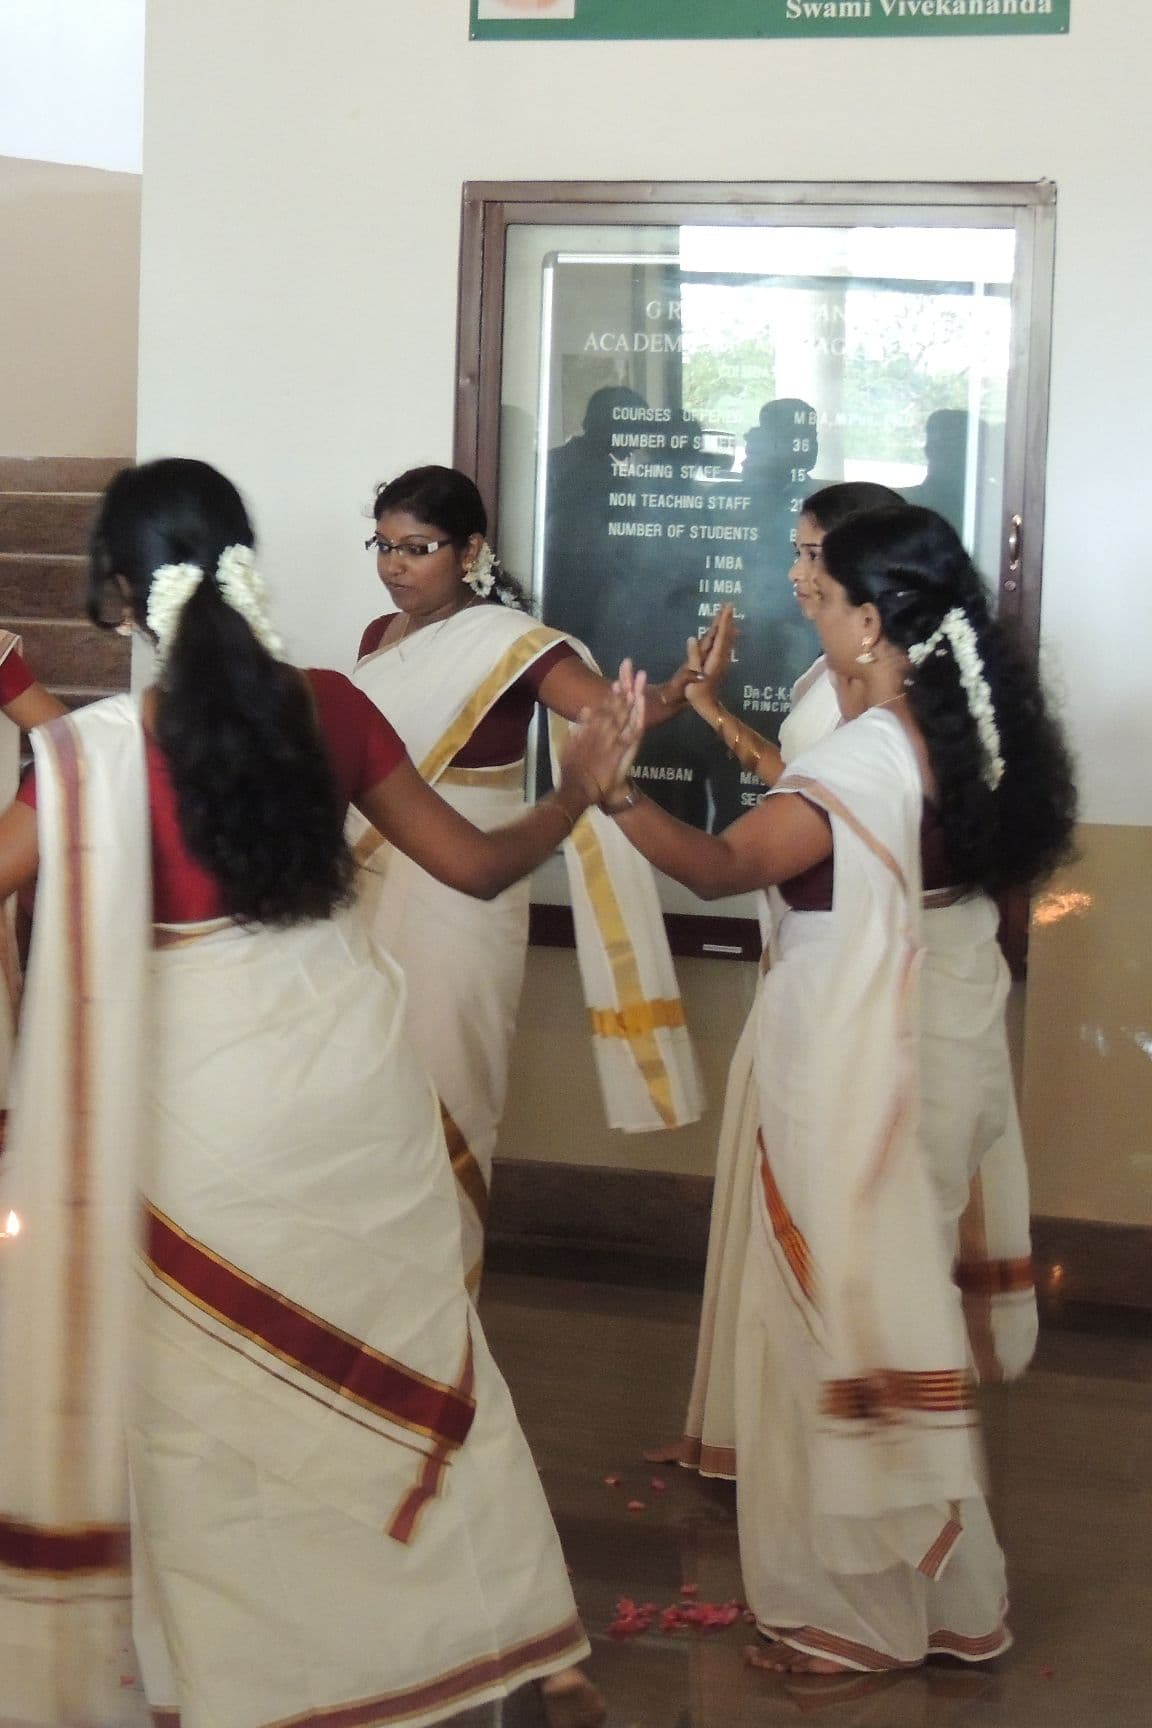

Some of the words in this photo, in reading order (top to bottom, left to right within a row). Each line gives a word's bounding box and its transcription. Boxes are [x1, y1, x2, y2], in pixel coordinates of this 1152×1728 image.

[786, 0, 872, 19] Swami
[584, 331, 699, 354] ACADEM
[612, 407, 672, 422] COURSES
[611, 434, 665, 448] NUMBER
[670, 435, 689, 449] OF
[792, 438, 810, 452] 36
[610, 463, 673, 479] TEACHING
[609, 493, 636, 507] NON
[641, 494, 704, 509] TEACHING
[707, 496, 752, 510] STAFF
[608, 522, 663, 537] NUMBER
[667, 524, 685, 538] OF
[689, 526, 759, 541] STUDENTS
[714, 556, 744, 570] MBA
[713, 580, 743, 594] MBA
